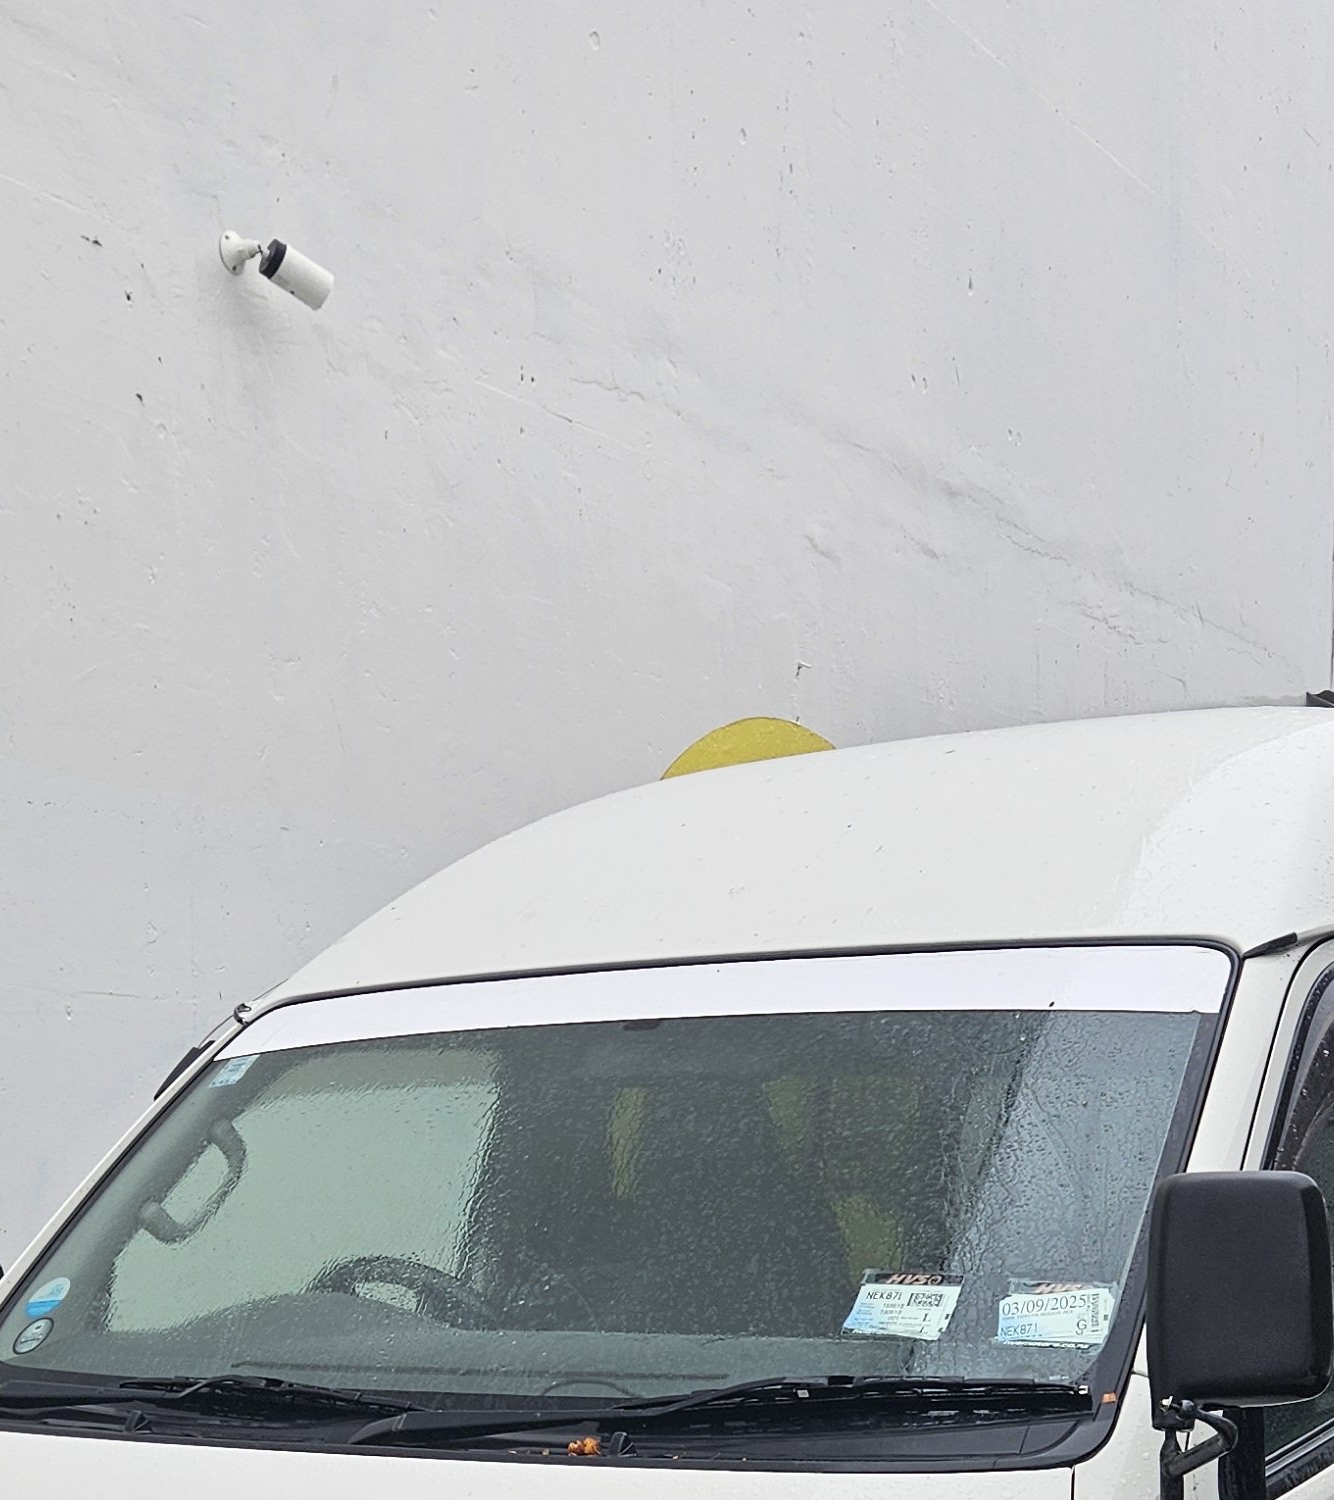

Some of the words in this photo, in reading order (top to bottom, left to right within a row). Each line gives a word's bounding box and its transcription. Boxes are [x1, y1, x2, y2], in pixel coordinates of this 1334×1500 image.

[866, 1291, 903, 1301] NEK871
[1002, 1294, 1086, 1316] 03/09/2025
[1000, 1323, 1038, 1337] NEK871
[1076, 1319, 1088, 1331] G
